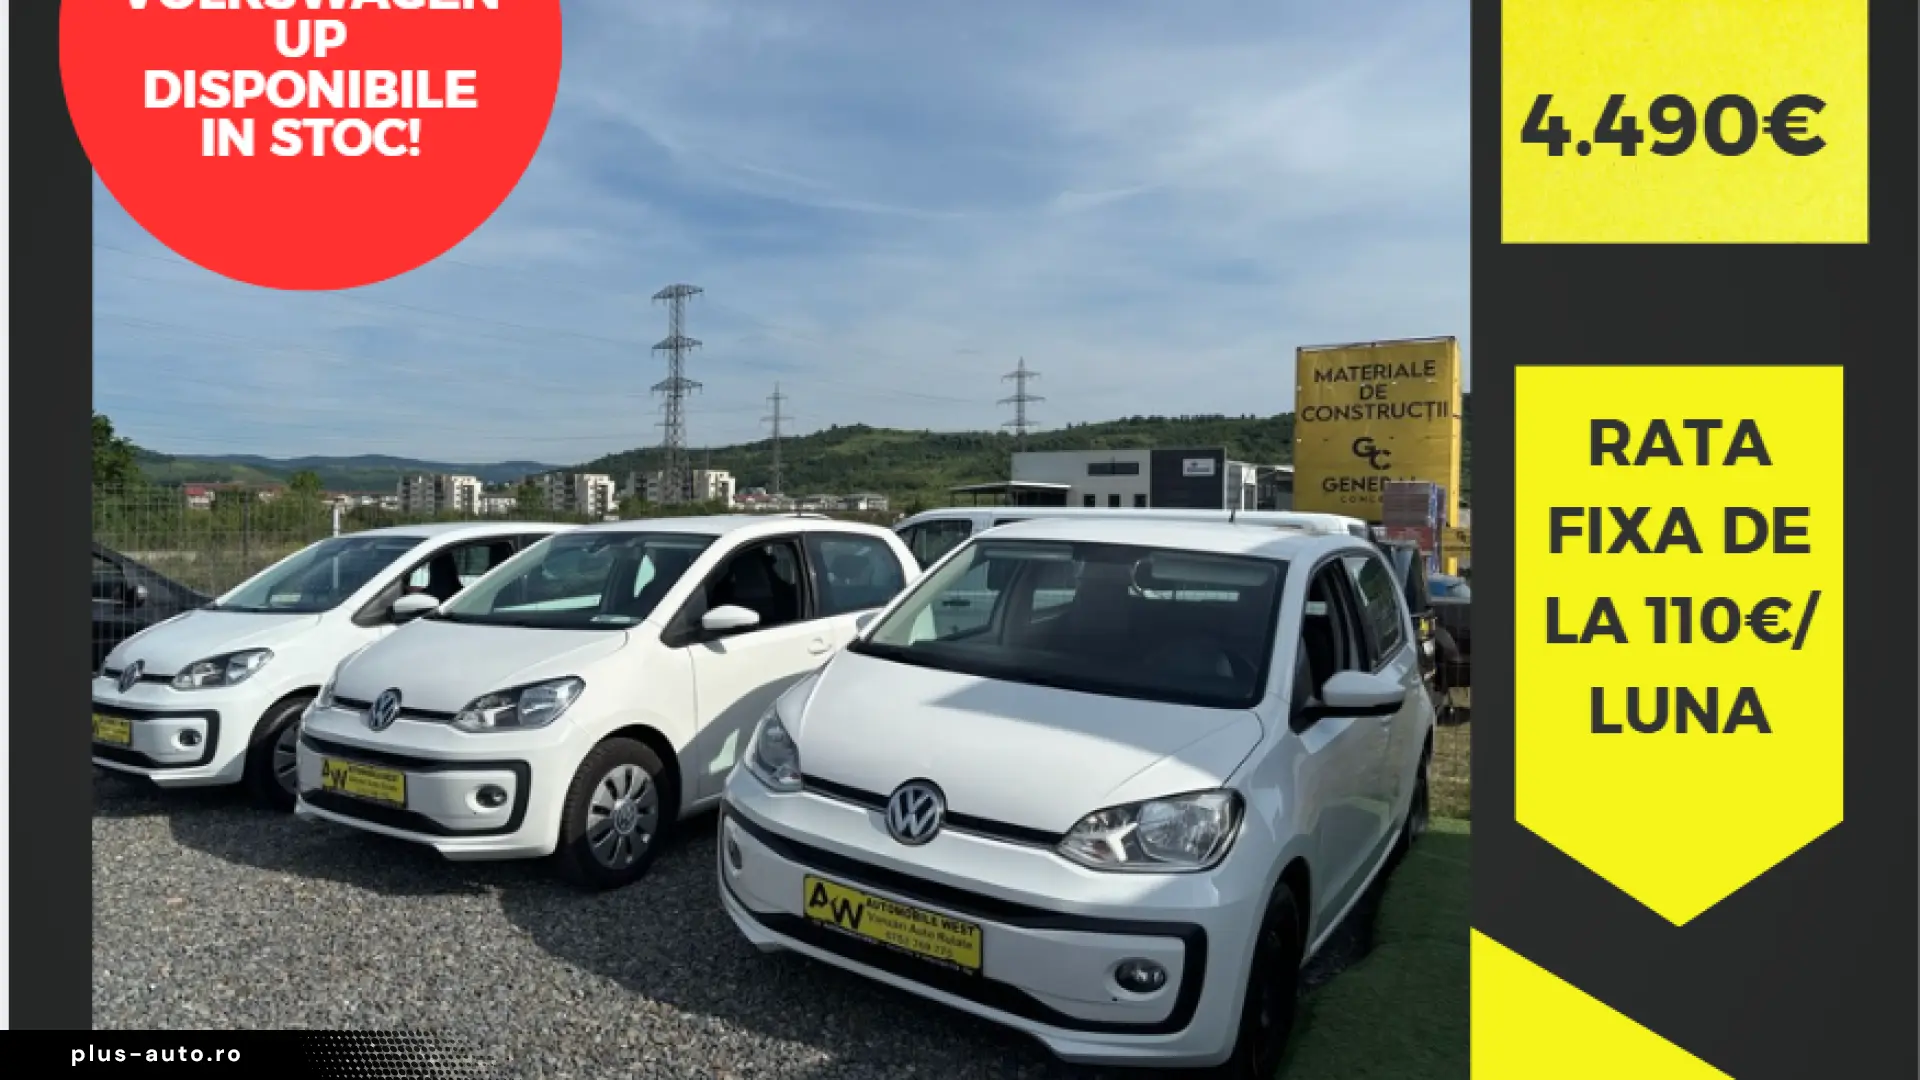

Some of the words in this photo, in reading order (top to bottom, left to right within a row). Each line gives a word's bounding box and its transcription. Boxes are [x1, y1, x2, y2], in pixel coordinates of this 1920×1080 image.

[1313, 360, 1436, 382] MATERIALE
[1359, 384, 1388, 400] DE
[866, 897, 938, 926] AUTOMOBILE
[940, 918, 974, 936] WEST
